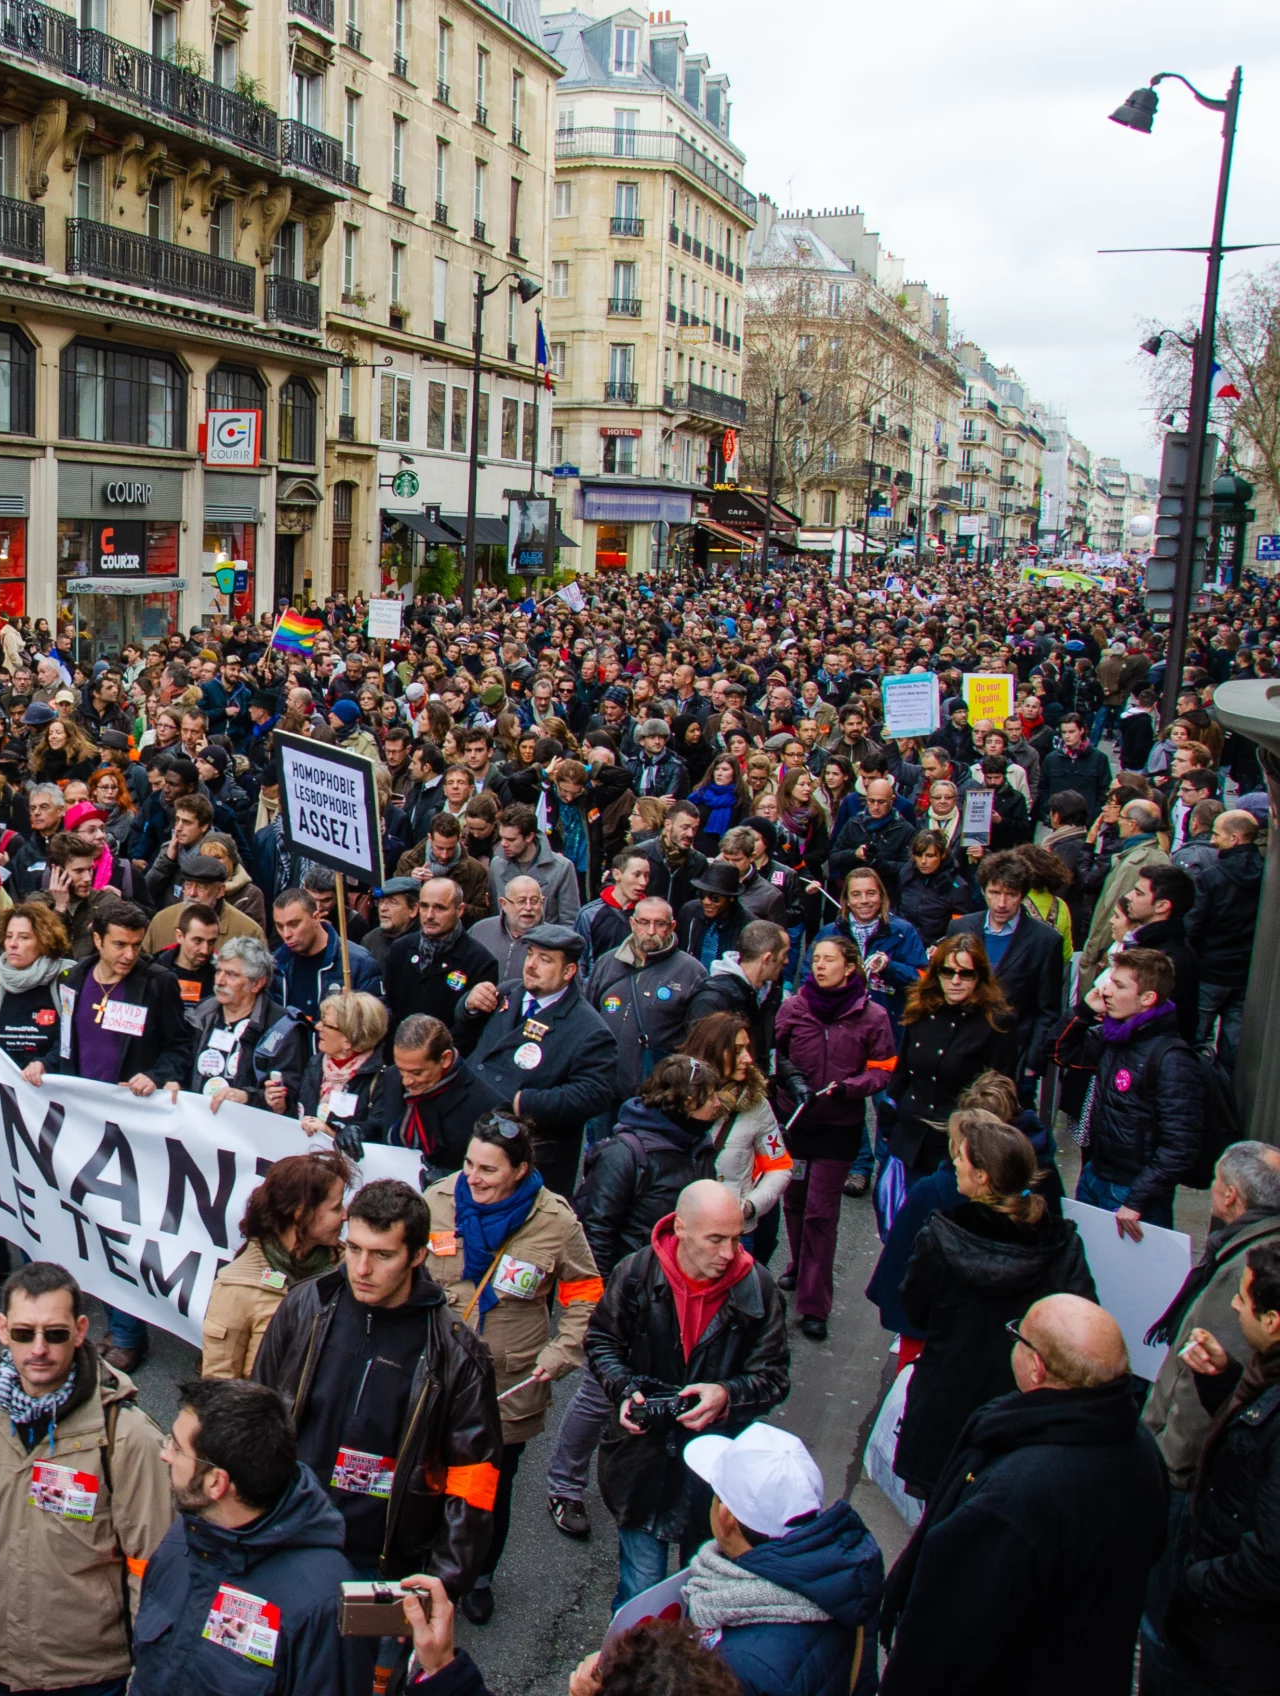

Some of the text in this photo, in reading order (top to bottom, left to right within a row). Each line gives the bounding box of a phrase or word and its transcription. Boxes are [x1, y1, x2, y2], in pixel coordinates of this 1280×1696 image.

[607, 428, 635, 436] HOTEL
[211, 449, 250, 459] COURIR
[725, 433, 733, 460] TABAC
[107, 481, 153, 504] COURIR
[713, 483, 735, 491] TABAC
[1258, 536, 1271, 550] P
[101, 553, 140, 569] COURIR
[520, 551, 543, 559] ALEX
[976, 682, 1001, 692] On veut
[982, 706, 994, 716] pas
[292, 760, 356, 798] HOMOPHOBIE
[294, 783, 358, 820] LESBOPHOBIE
[298, 806, 361, 854] ASSEZ !
[110, 1002, 142, 1018] DAVID
[66, 1507, 88, 1516] PROMIS
[222, 1605, 238, 1615] POUR
[232, 1597, 261, 1614] MARIAGE
[223, 1637, 246, 1652] COMME
[248, 1646, 269, 1659] PROMIS
